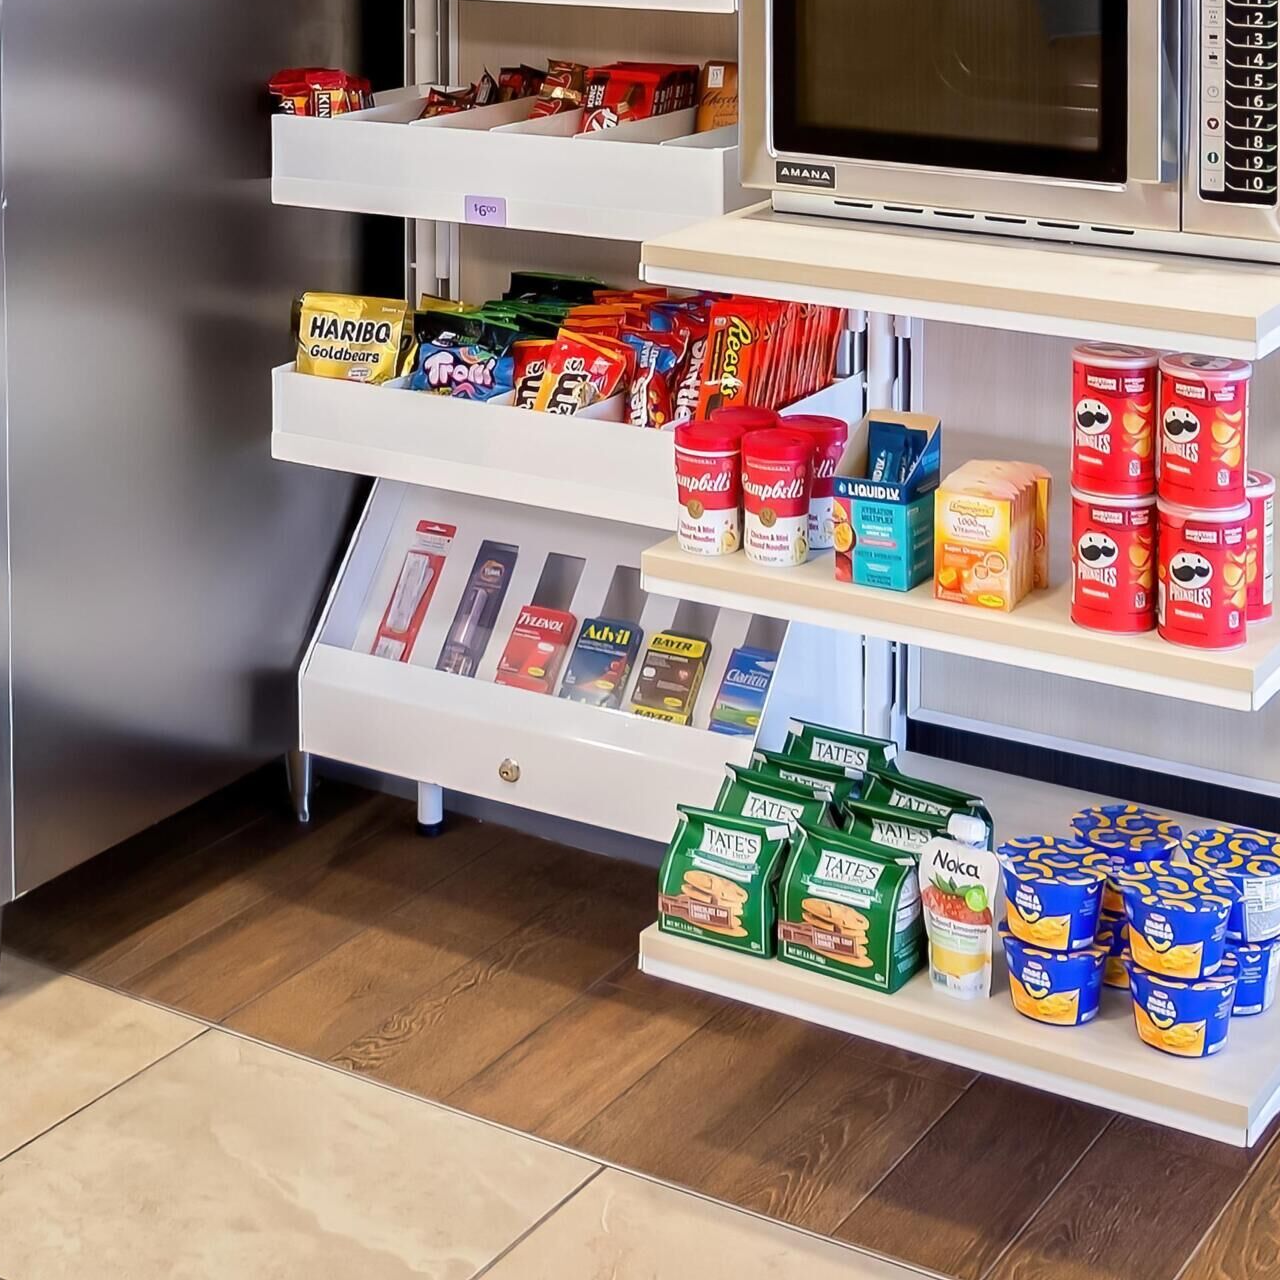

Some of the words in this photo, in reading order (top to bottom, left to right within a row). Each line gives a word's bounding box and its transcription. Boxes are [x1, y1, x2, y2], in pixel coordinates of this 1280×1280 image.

[1253, 12, 1263, 26] 2
[1253, 32, 1263, 46] 3
[1253, 53, 1263, 66] 4
[1253, 74, 1263, 87] 5
[318, 93, 331, 118] KIN
[1253, 94, 1263, 108] 6
[1253, 115, 1263, 128] 7
[1253, 135, 1263, 148] 8
[780, 166, 831, 180] AMANA
[1253, 156, 1263, 169] 9
[1253, 176, 1263, 190] 0
[309, 316, 391, 343] HARIBO
[310, 344, 380, 363] Goldbears
[720, 315, 752, 398] Reese's
[423, 351, 498, 388] Trolli
[675, 339, 707, 420] Skittle
[1075, 426, 1111, 455] PRINGLES
[1163, 435, 1199, 464] PRINGLES
[847, 483, 885, 500] LIQUID
[1077, 560, 1117, 588] PRINGLES
[1169, 583, 1212, 609] PRINGLES
[518, 612, 564, 632] TYLENOL
[583, 624, 631, 646] Advil
[652, 636, 693, 652] BAYER
[726, 669, 768, 689] Claritin
[814, 740, 867, 767] TATE'S
[706, 827, 758, 855] TATE'S
[876, 820, 930, 845] TATE'S
[824, 854, 880, 881] TATE'S
[932, 848, 981, 880] Noka
